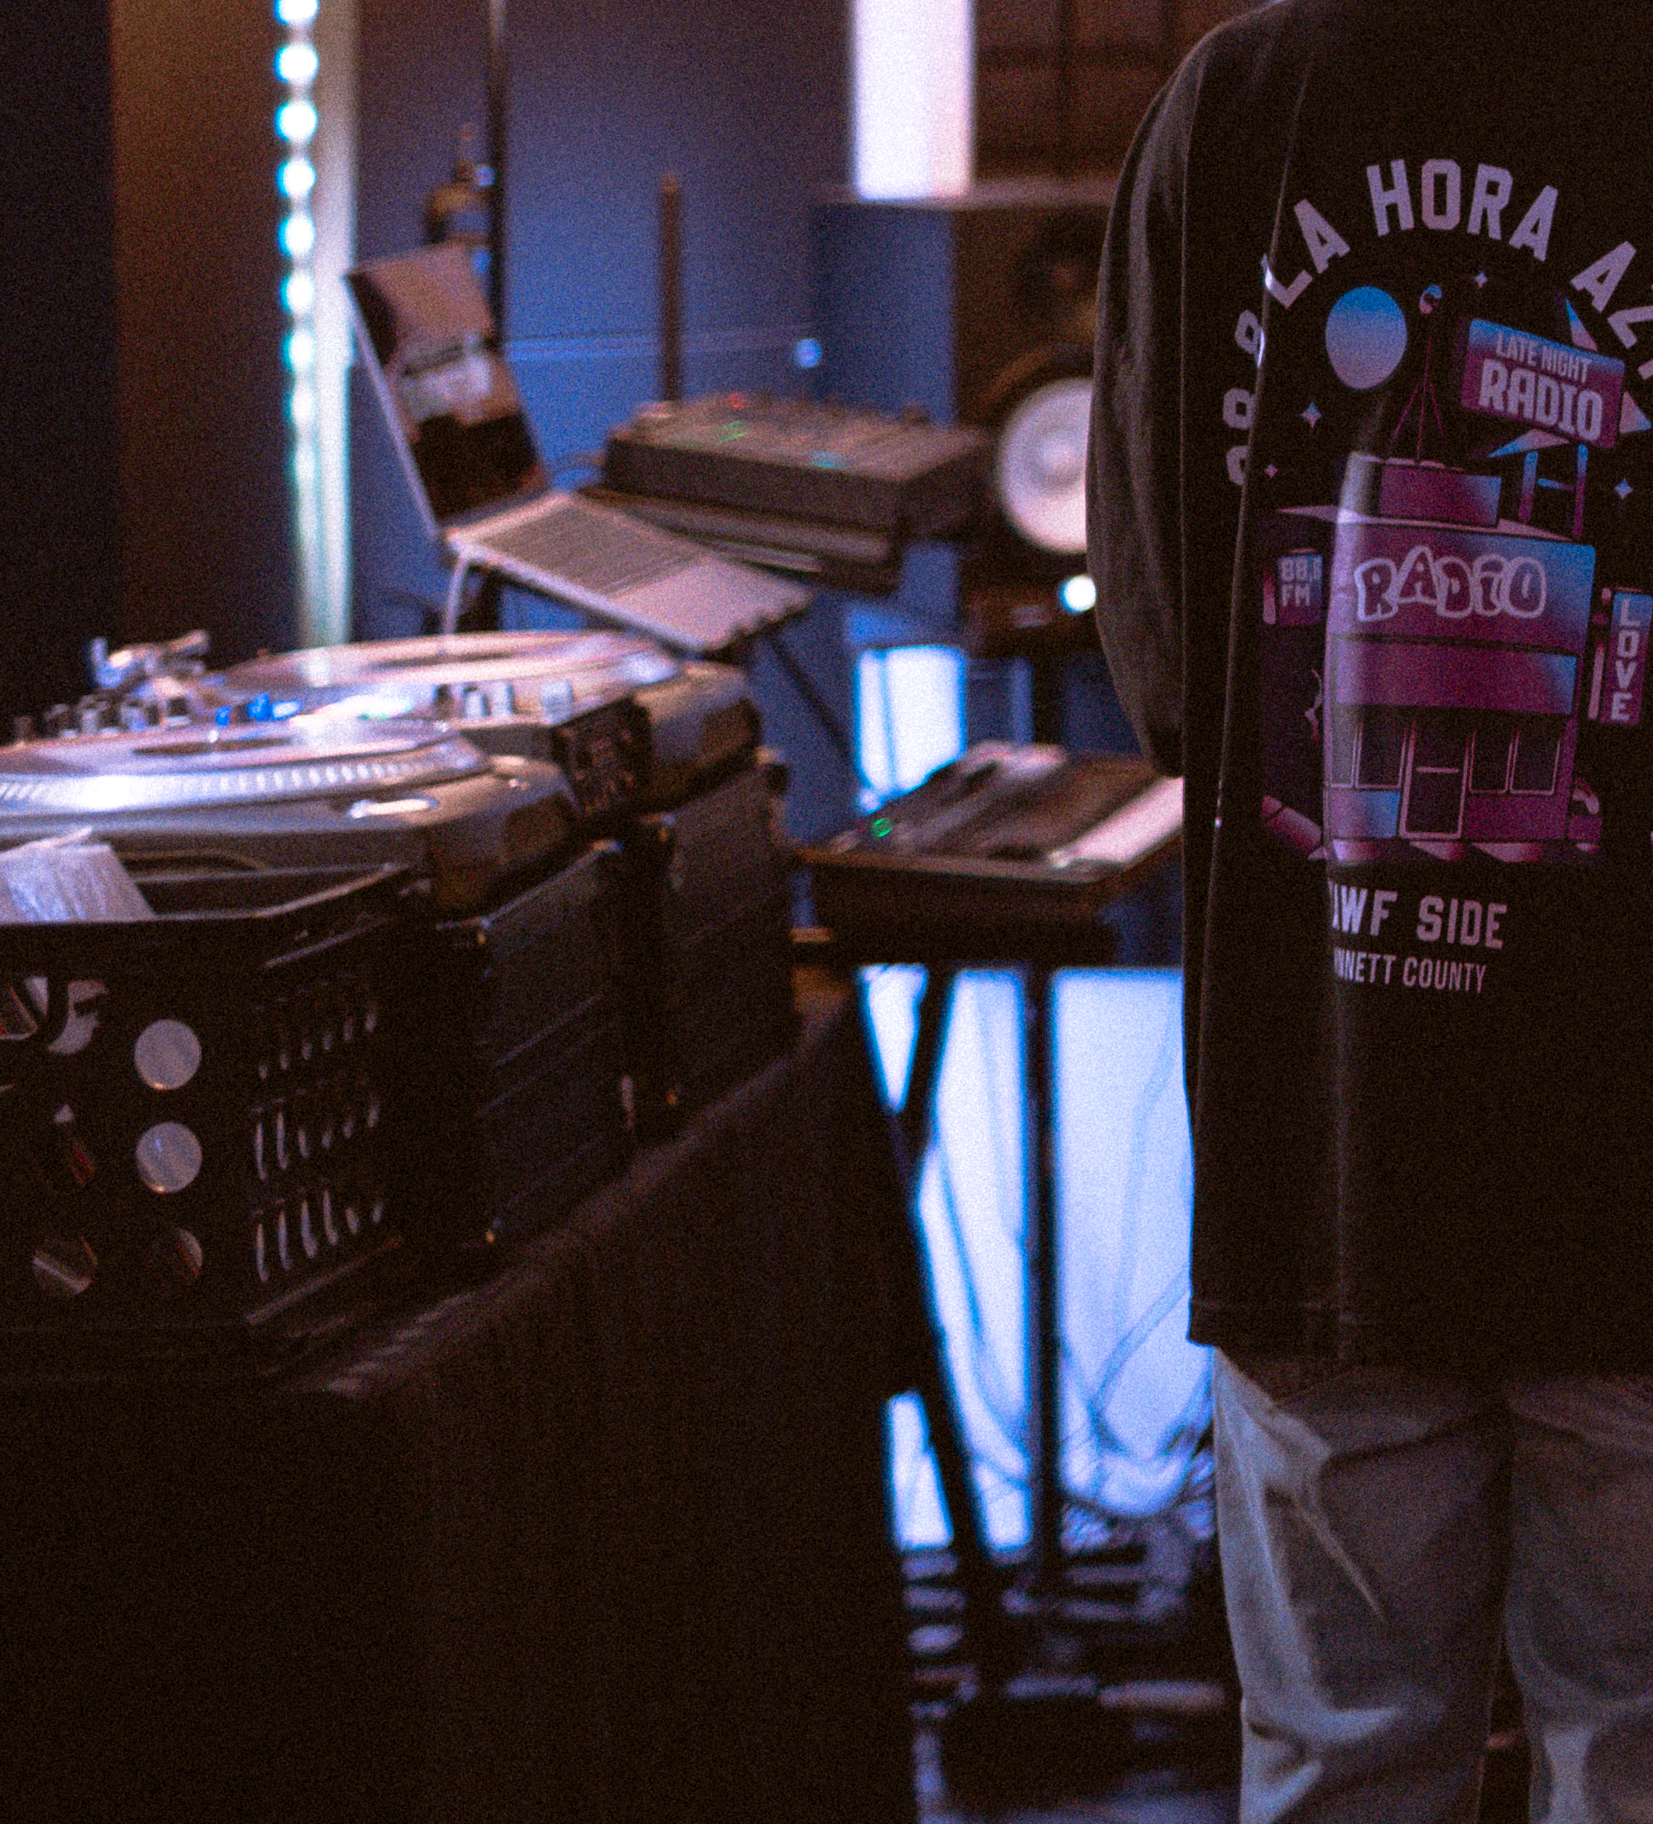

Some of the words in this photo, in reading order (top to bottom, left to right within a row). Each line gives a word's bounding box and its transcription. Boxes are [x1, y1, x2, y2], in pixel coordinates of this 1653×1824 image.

[1260, 198, 1351, 310] LA
[1366, 158, 1559, 263] HORA
[1495, 330, 1540, 368] LATE
[1541, 344, 1594, 385] NIGHT
[1478, 357, 1604, 443] RADIO
[1281, 584, 1311, 608] FM
[1353, 545, 1547, 622] RADIO
[1610, 597, 1642, 723] LOVE
[1416, 894, 1508, 950] SIDE
[1402, 955, 1486, 995] COUNTY
